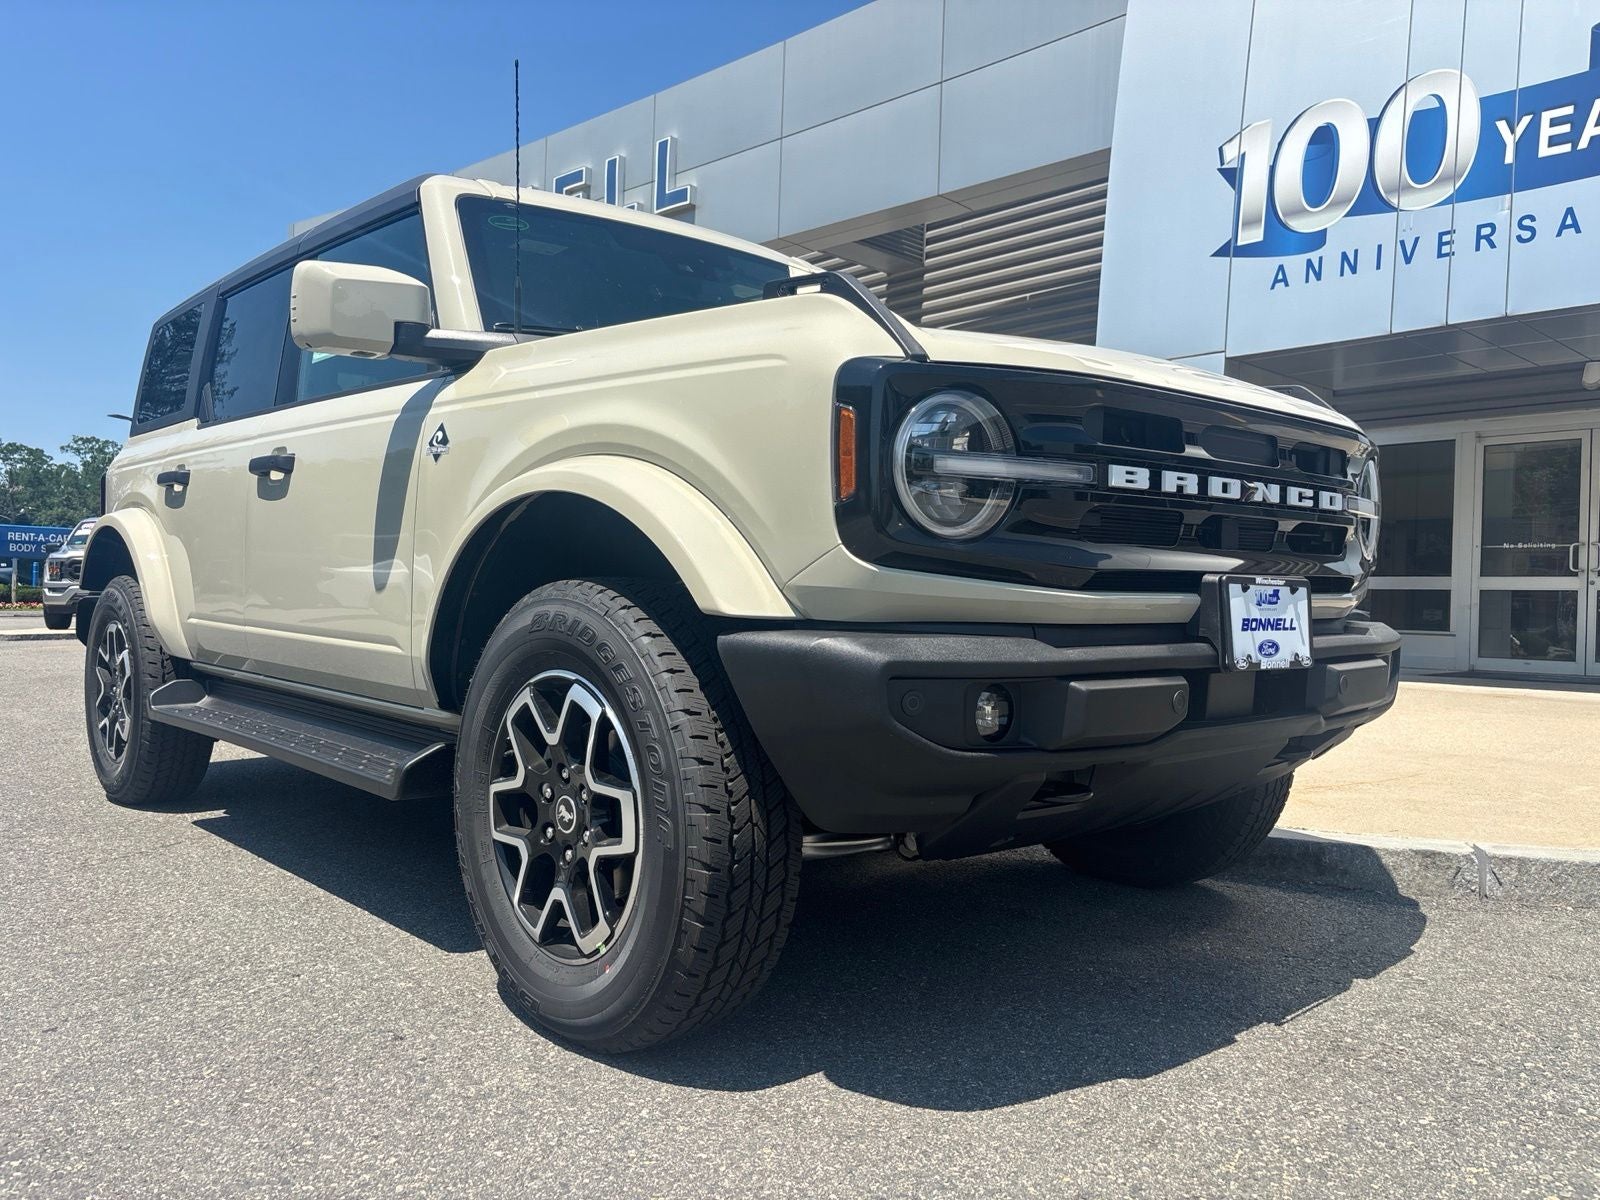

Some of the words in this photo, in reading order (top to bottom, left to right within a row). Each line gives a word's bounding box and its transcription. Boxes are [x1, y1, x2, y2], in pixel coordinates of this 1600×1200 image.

[1218, 68, 1482, 246] 100
[1269, 205, 1583, 291] ANNIVERSA
[1107, 463, 1343, 511] BRONCO
[9, 543, 37, 552] BODY
[1241, 617, 1297, 632] BONNELL
[1260, 659, 1290, 669] Bonnell
